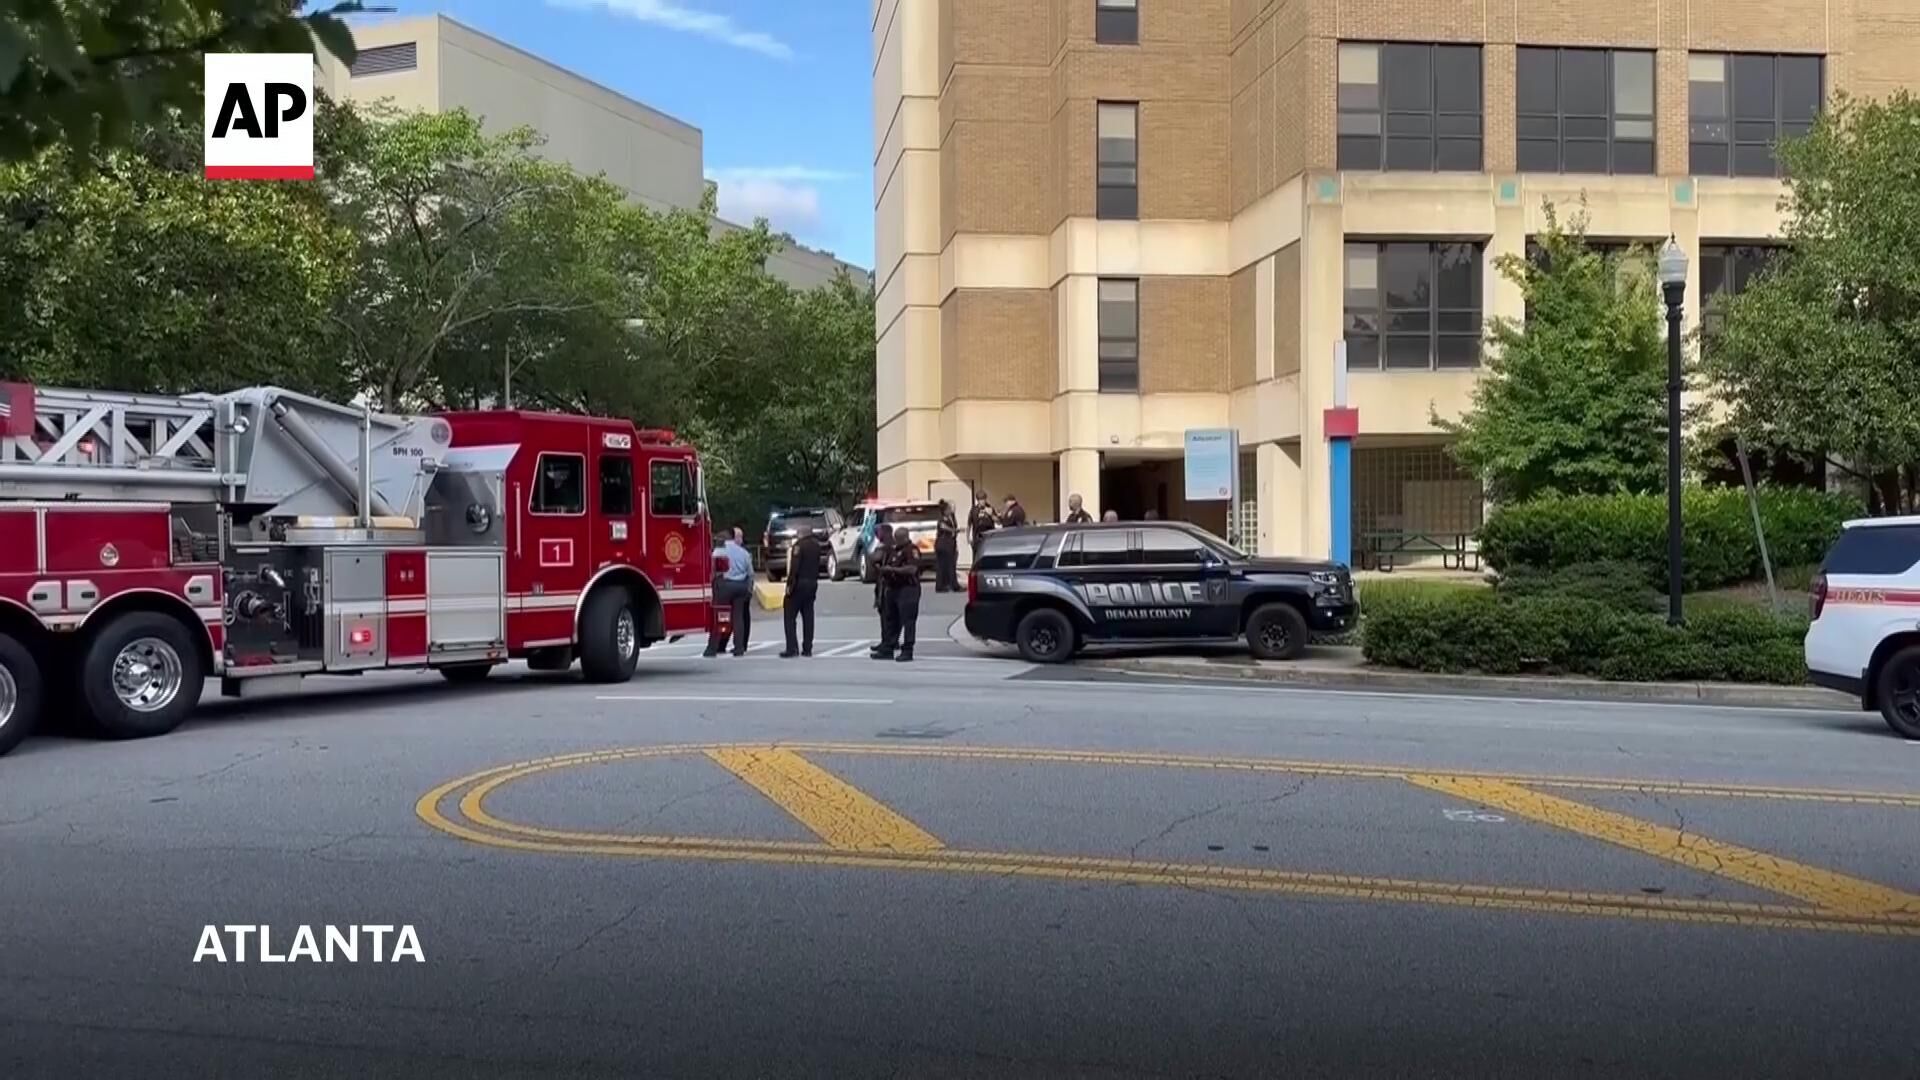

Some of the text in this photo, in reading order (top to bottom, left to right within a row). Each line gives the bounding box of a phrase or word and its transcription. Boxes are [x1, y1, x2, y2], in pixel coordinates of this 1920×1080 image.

[410, 448, 424, 457] 100
[552, 544, 561, 562] 1
[986, 578, 1012, 588] 911
[1083, 582, 1201, 606] POLICE
[1105, 608, 1191, 619] DEKALB COUNTY
